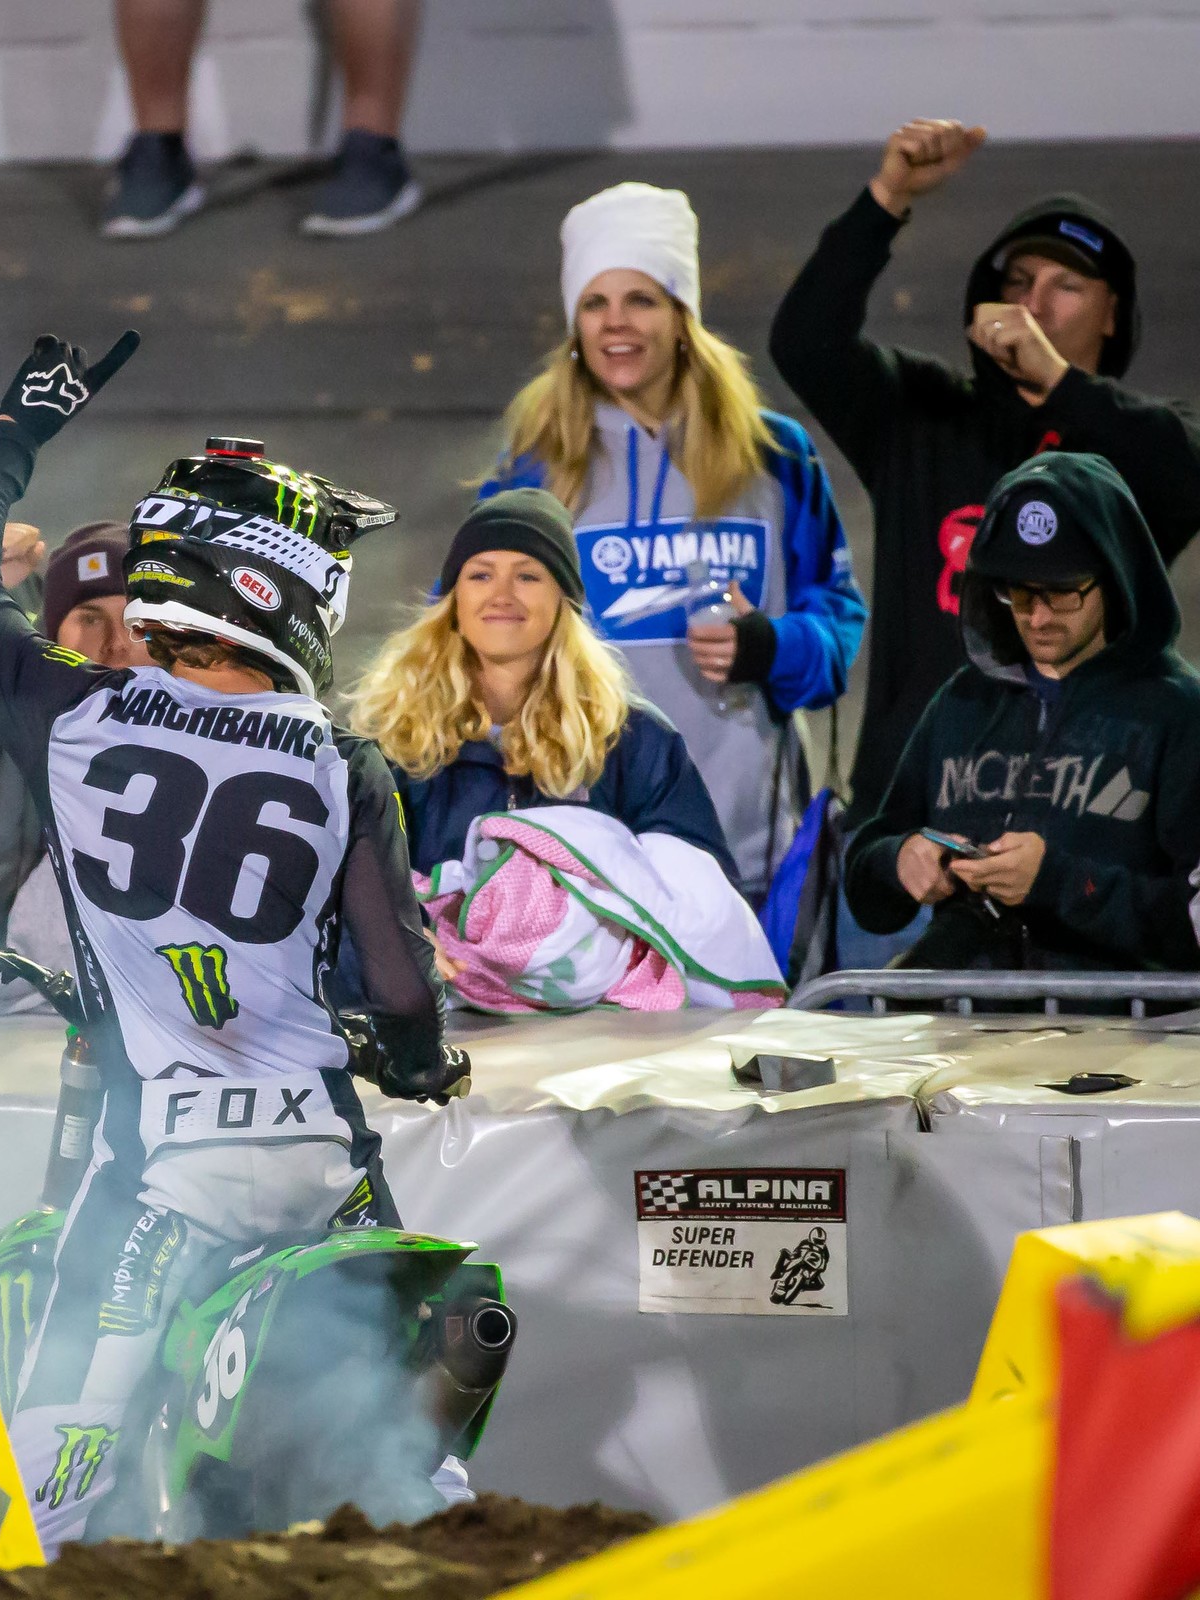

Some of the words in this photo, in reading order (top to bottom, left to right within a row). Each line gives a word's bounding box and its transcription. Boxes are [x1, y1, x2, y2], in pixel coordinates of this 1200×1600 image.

[631, 532, 758, 571] YAMAHA
[239, 572, 273, 606] BELL
[72, 743, 329, 944] 36
[165, 1088, 313, 1136] FOX
[698, 1179, 832, 1200] ALPINA
[672, 1226, 736, 1246] SUPER
[652, 1249, 755, 1269] DEFENDER
[197, 1288, 253, 1430] 36
